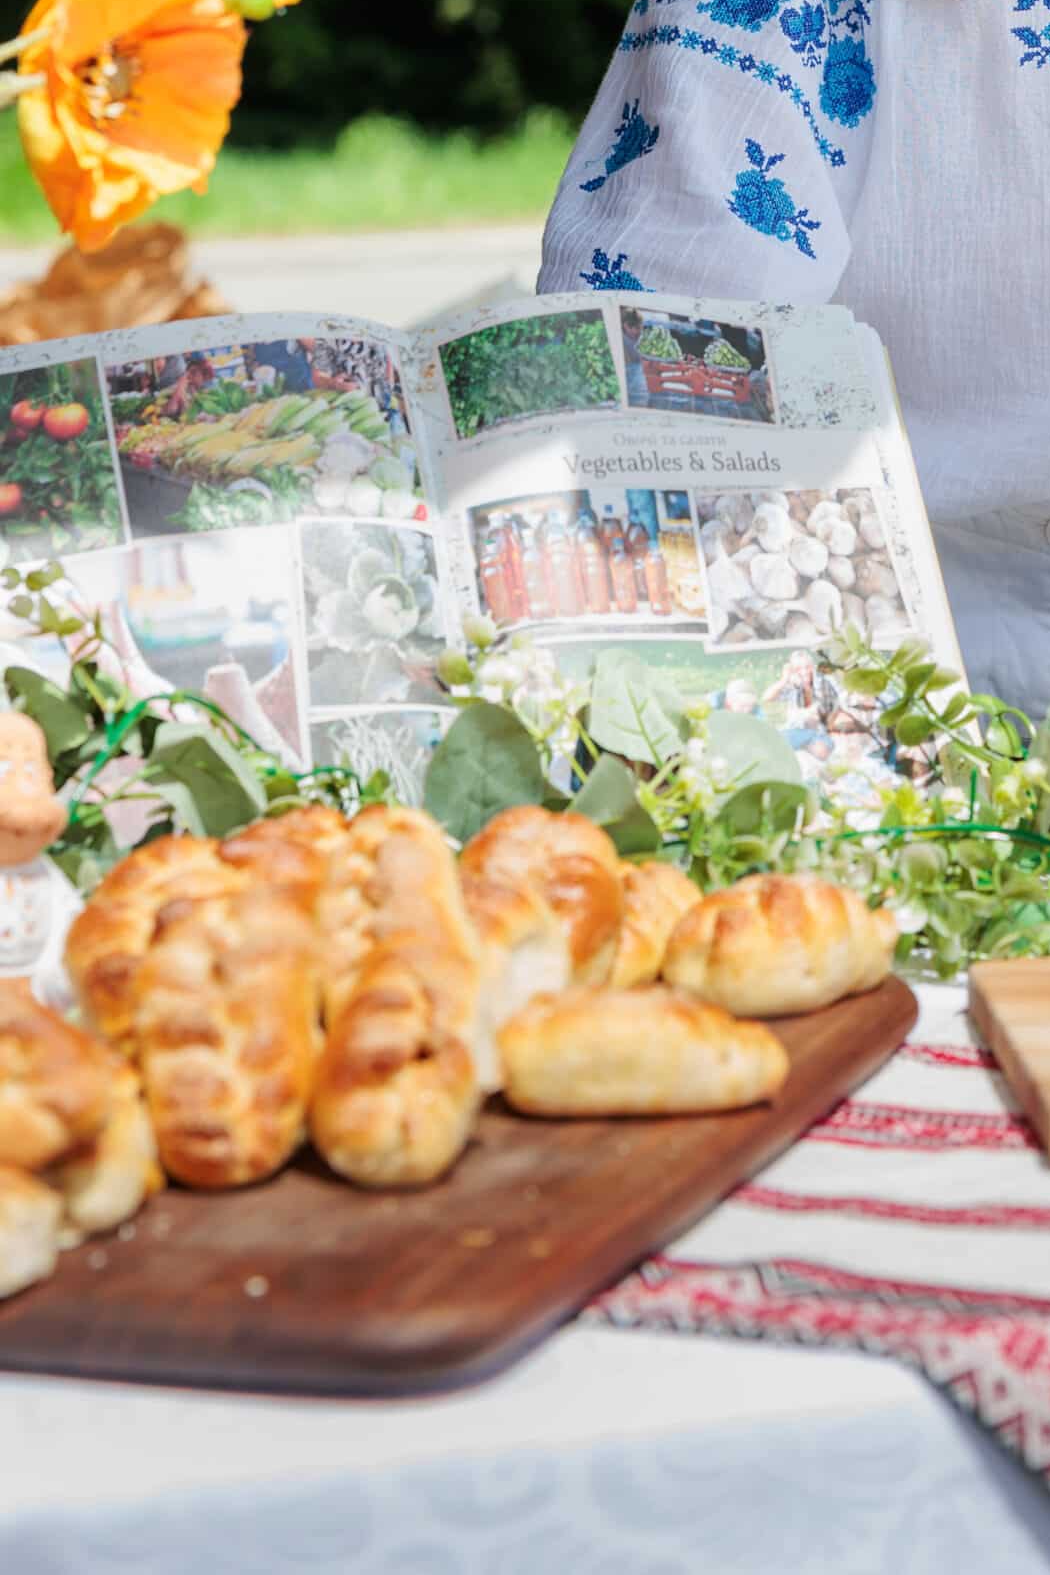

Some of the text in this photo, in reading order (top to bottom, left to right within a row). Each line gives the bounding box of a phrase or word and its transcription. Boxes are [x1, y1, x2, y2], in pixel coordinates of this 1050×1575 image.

[563, 449, 782, 479] Vegetables & Salads
